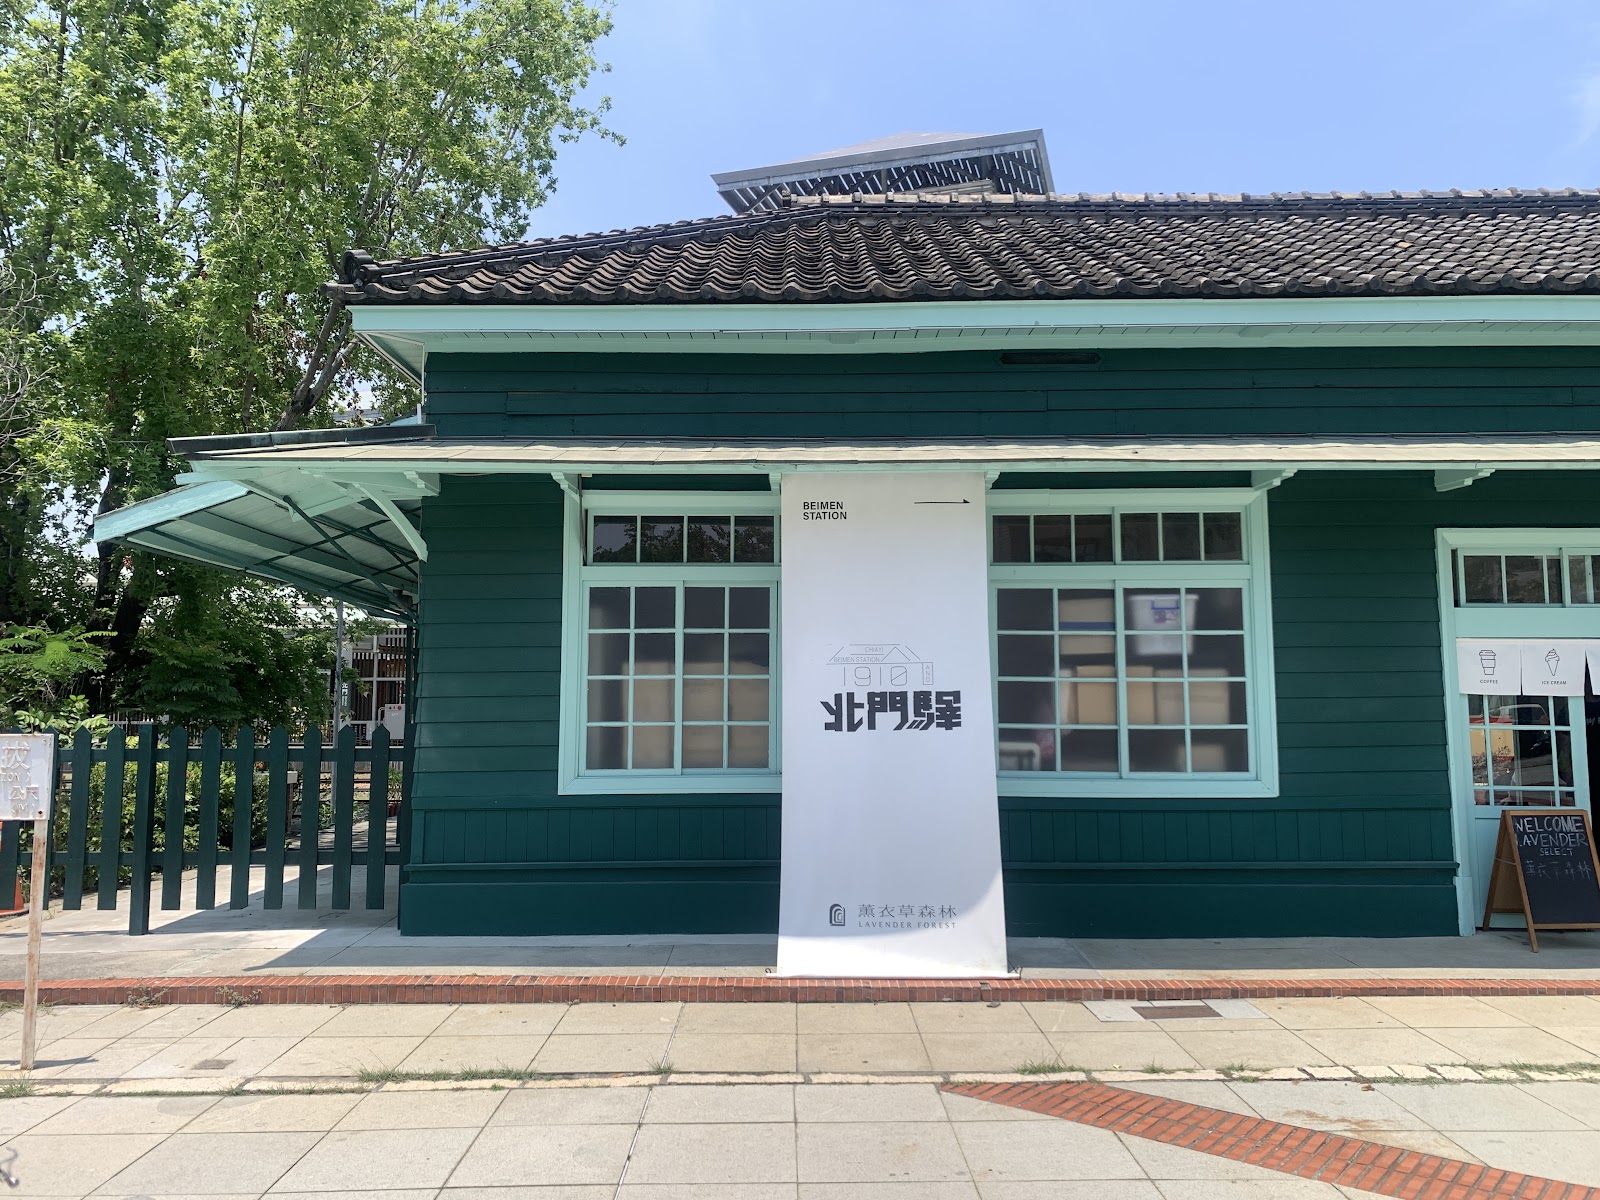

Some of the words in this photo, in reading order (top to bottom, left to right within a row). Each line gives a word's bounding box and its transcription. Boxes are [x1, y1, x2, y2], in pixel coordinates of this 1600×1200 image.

[803, 501, 844, 510] BEIMEN
[803, 511, 847, 520] STATION
[843, 665, 908, 686] 1910
[820, 690, 962, 732] 北門驛
[1539, 847, 1574, 857] SELECT
[858, 921, 913, 929] LAVENDER
[917, 921, 957, 929] FOREST
